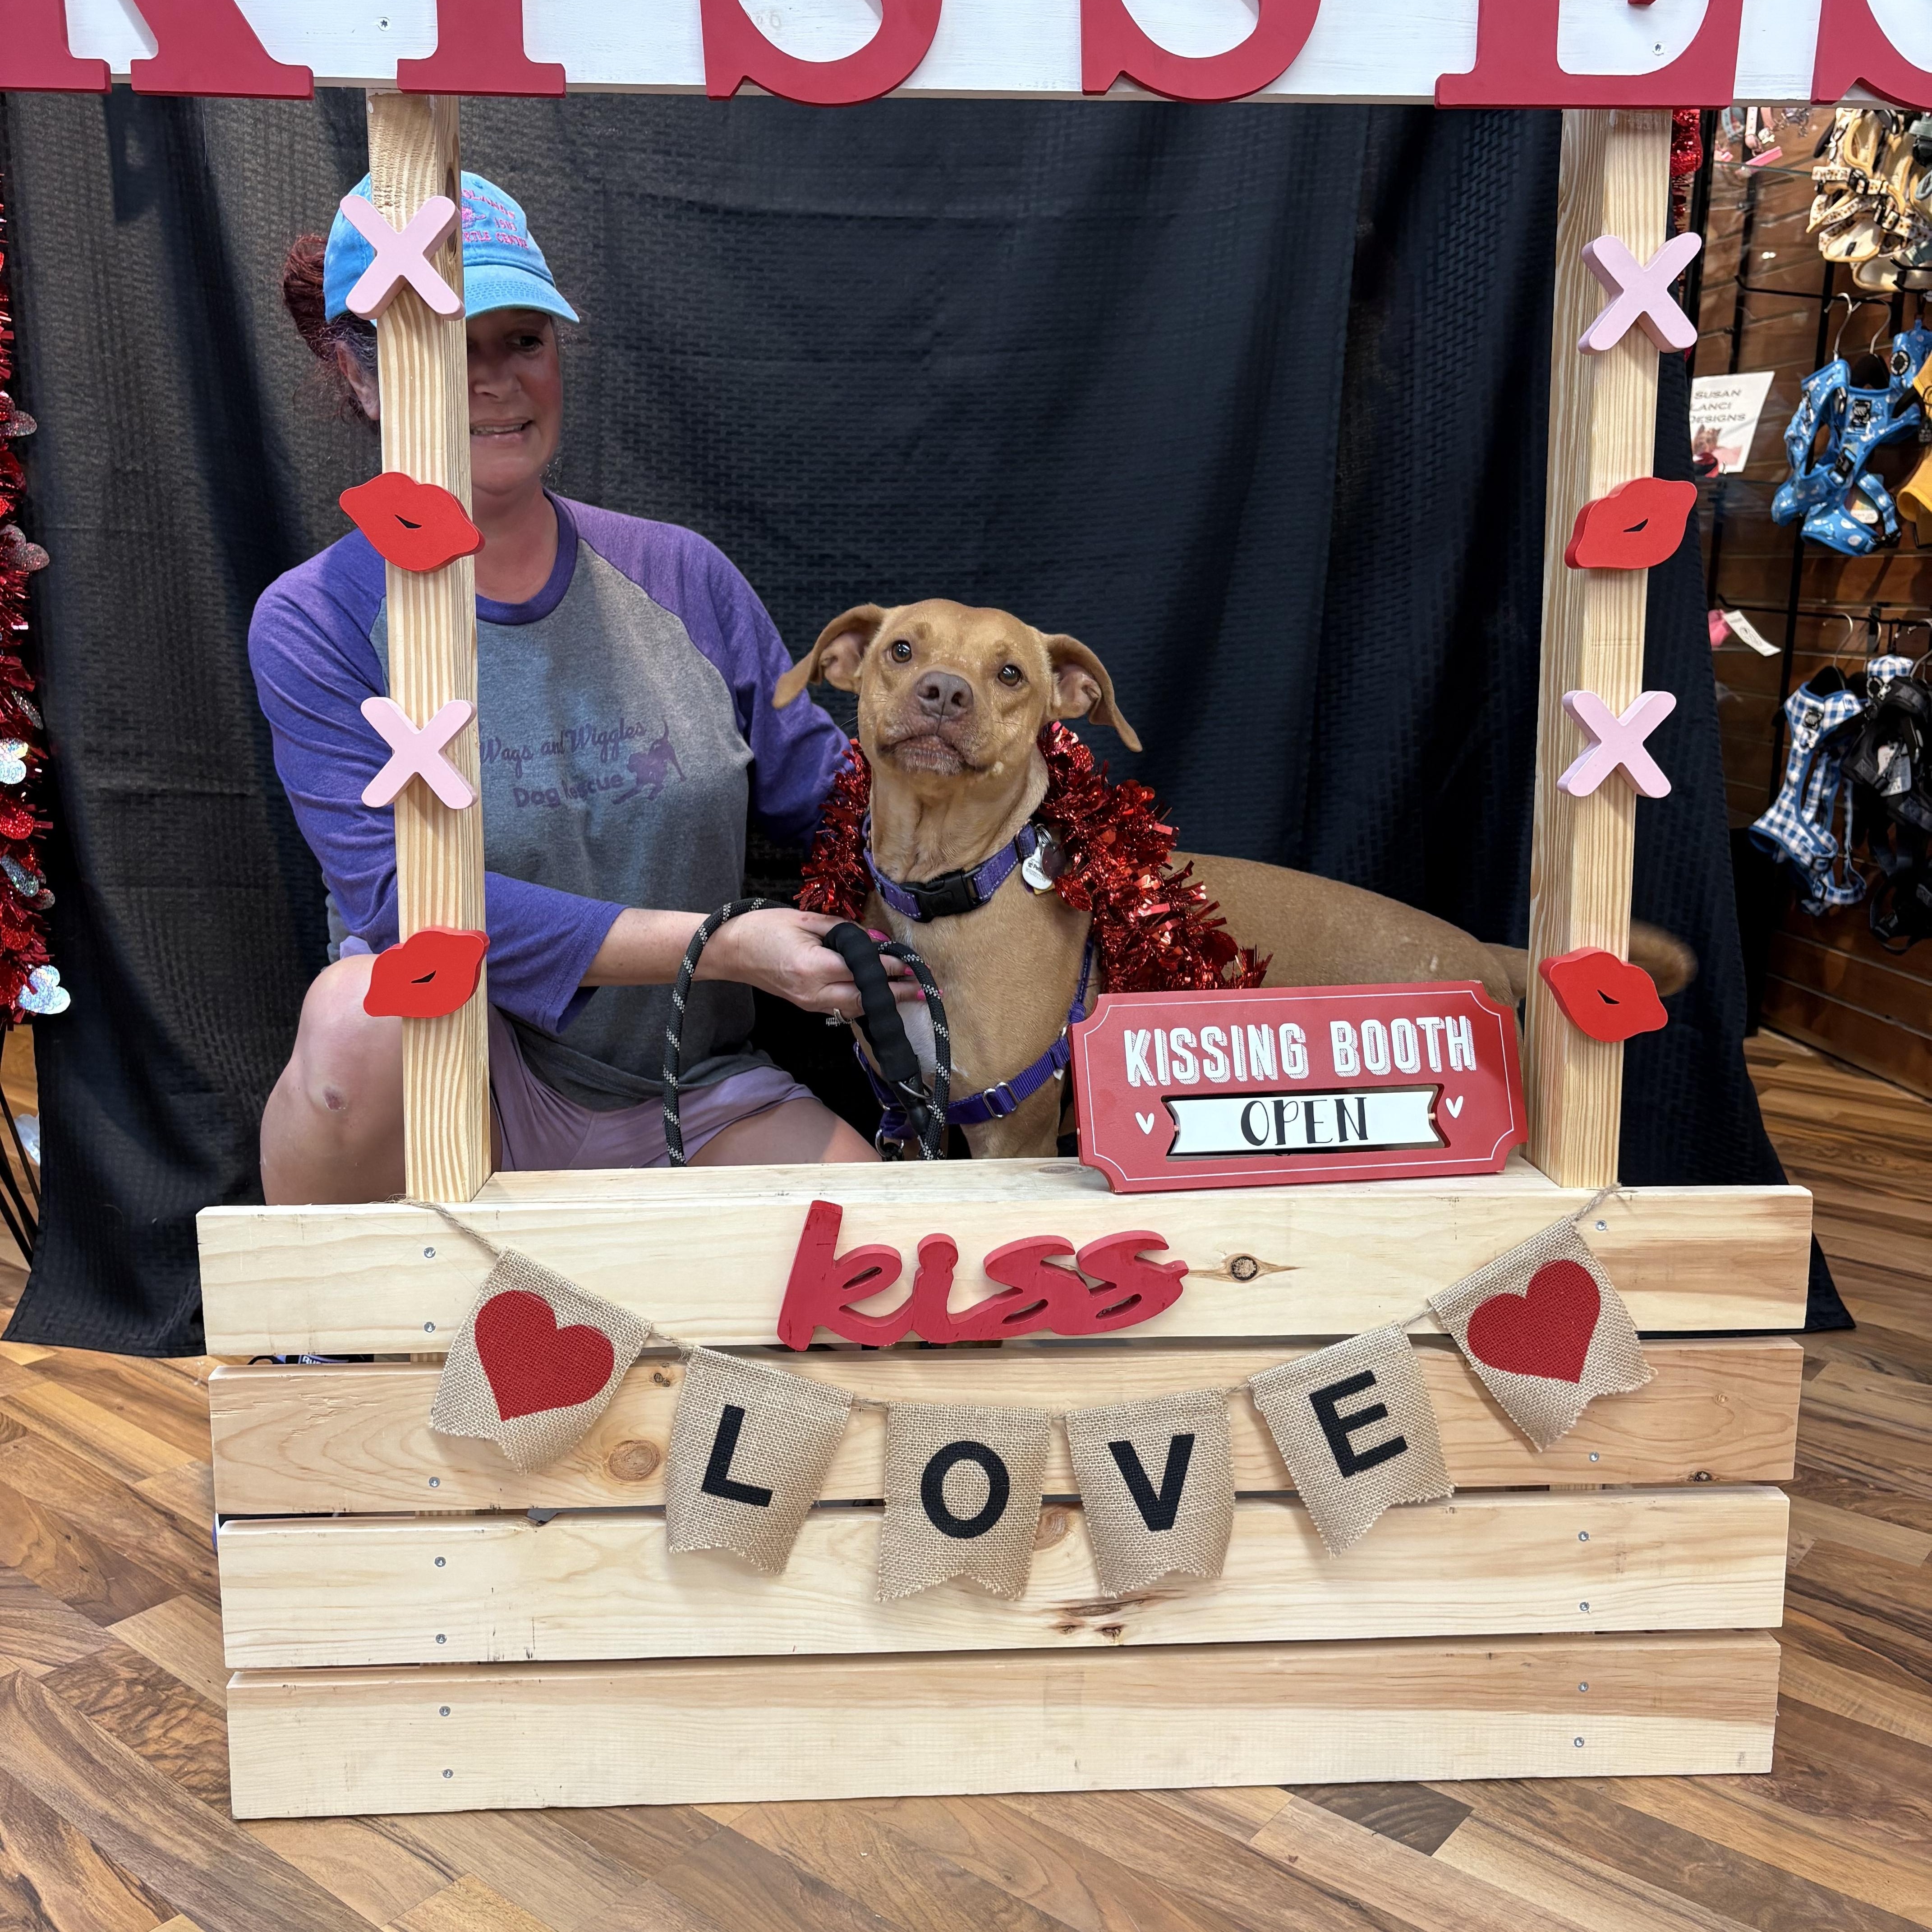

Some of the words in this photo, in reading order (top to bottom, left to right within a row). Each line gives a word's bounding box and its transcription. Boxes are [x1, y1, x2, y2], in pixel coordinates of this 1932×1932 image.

[462, 230, 492, 243] RTLE
[1694, 390, 1742, 400] SUSAN
[541, 731, 565, 756] and
[565, 718, 646, 764] Wiggles
[513, 787, 561, 808] Dog
[1124, 1023, 1309, 1087] KISSING
[1329, 1015, 1477, 1077] BOOTH
[1241, 1097, 1368, 1146] OPEN
[777, 1200, 1189, 1352] kiss
